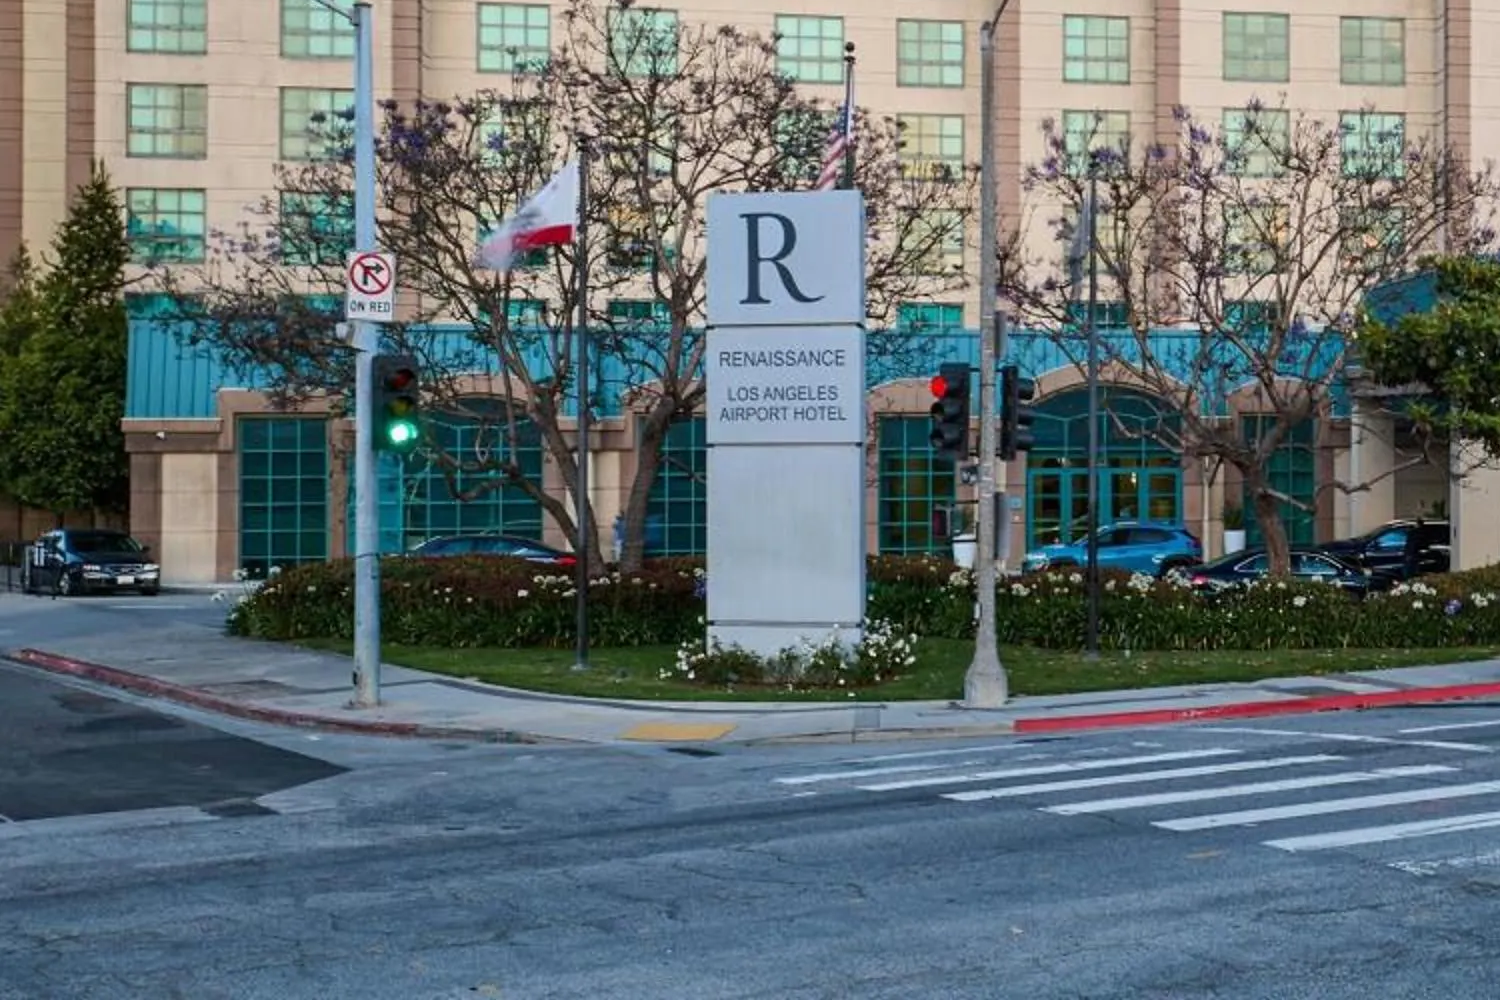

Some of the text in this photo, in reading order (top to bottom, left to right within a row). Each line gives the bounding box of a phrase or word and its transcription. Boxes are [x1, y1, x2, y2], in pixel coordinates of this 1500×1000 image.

[738, 212, 826, 305] R
[350, 300, 391, 313] ON RED
[719, 349, 846, 367] RENAISSANCE
[727, 385, 839, 401] LOS ANGELES
[719, 406, 847, 422] AIRPORT HOTEL
